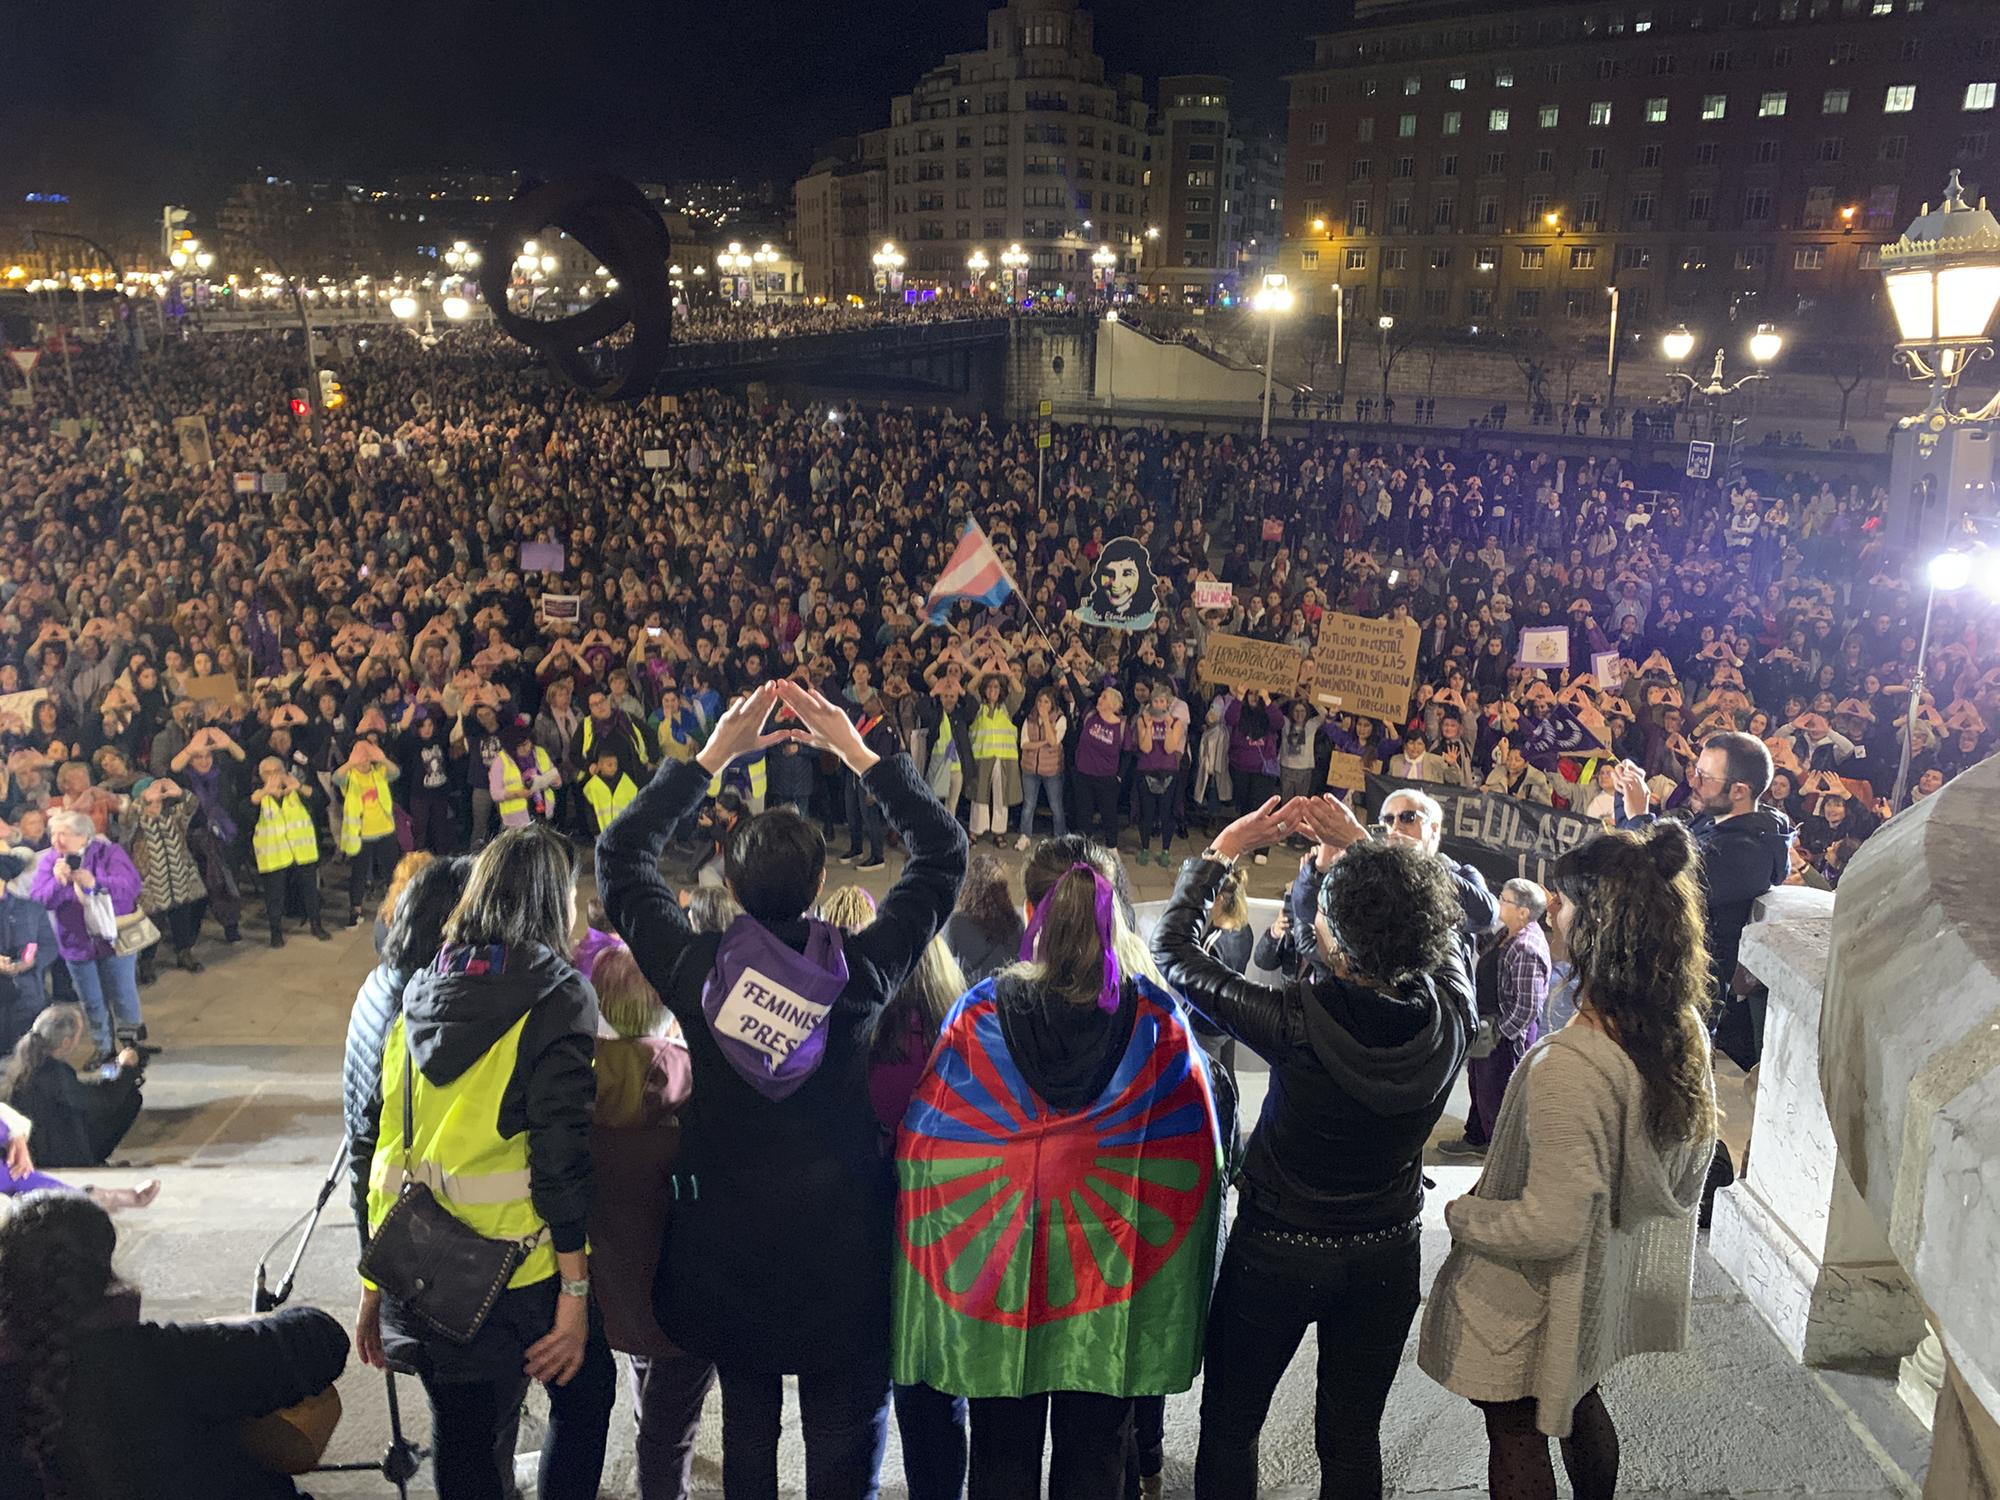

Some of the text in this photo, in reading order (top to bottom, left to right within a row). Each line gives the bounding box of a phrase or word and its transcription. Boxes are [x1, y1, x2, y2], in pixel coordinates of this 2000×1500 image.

[1342, 618, 1405, 640] TU ROMPES
[1331, 632, 1357, 647] TECHO
[1318, 646, 1326, 657] Y
[1382, 654, 1407, 670] LAS
[1355, 668, 1367, 681] EN
[1356, 698, 1402, 717] IRREGULAR
